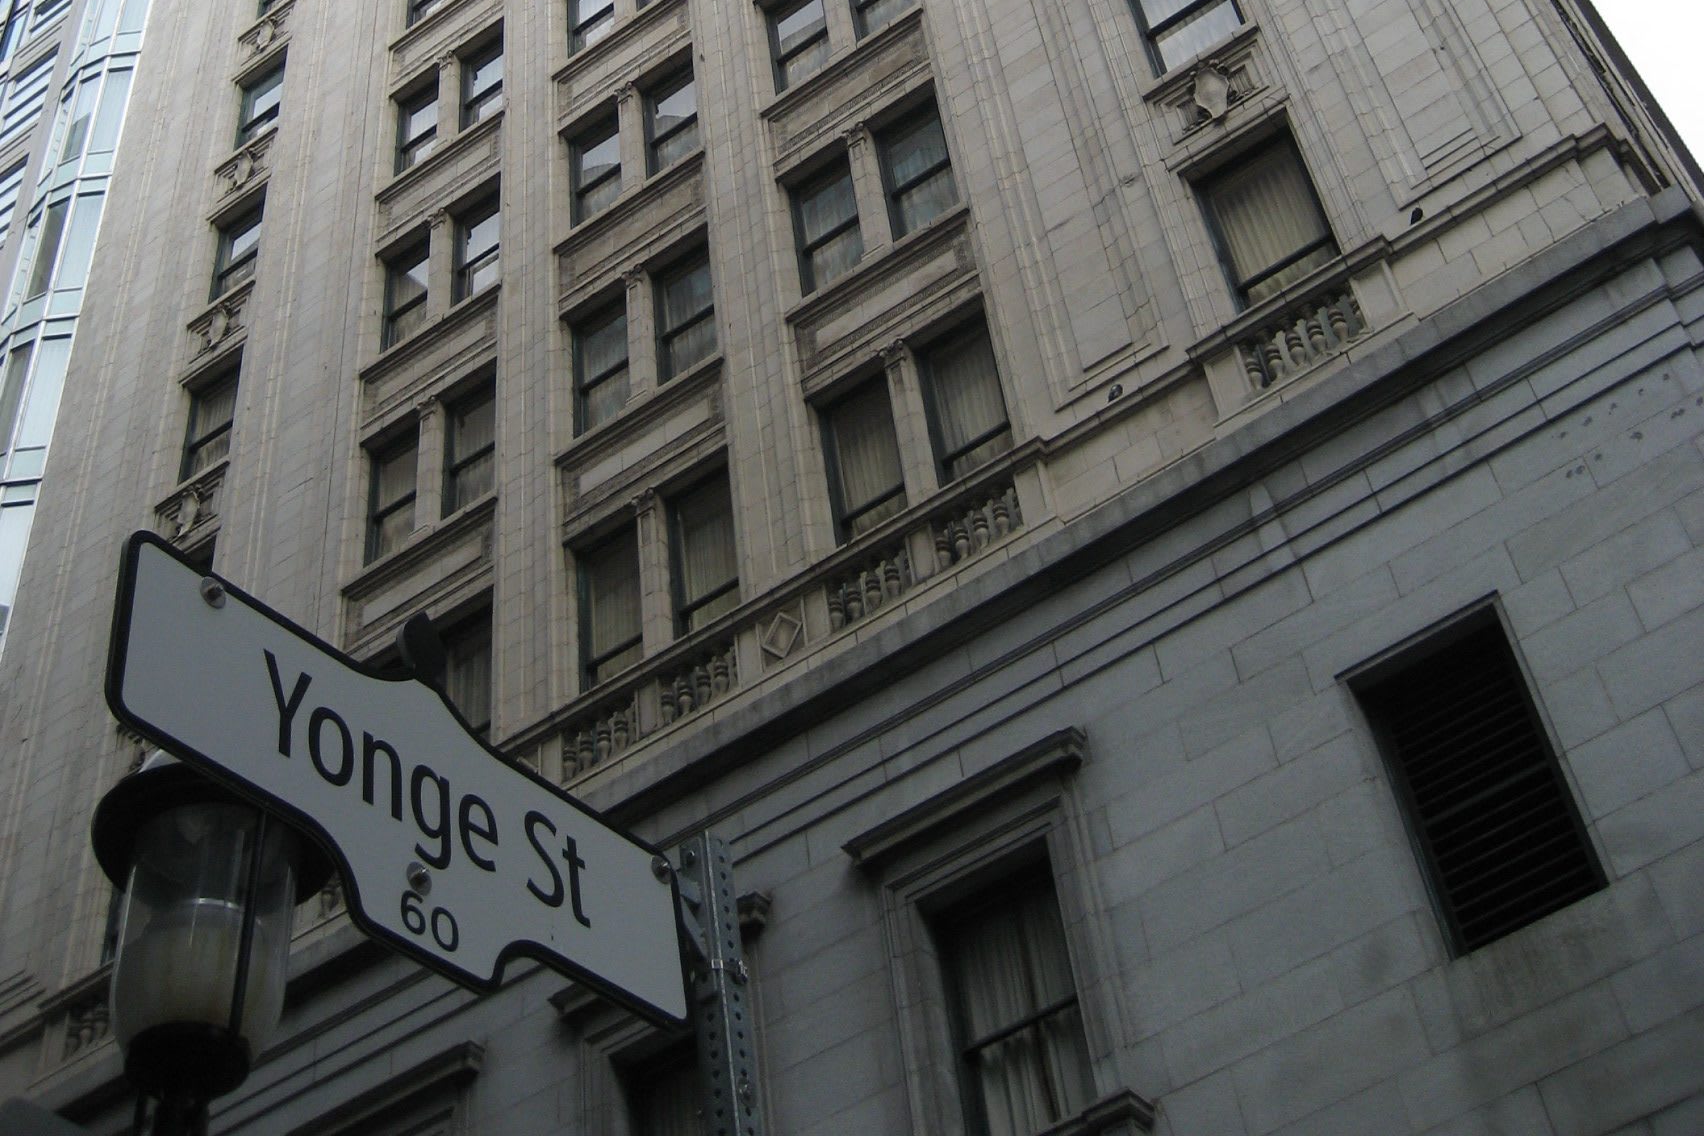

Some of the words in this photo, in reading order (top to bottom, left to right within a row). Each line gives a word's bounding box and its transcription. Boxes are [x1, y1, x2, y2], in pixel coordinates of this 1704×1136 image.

[263, 648, 500, 873] Yonge
[523, 809, 592, 930] St
[400, 888, 461, 954] 60
